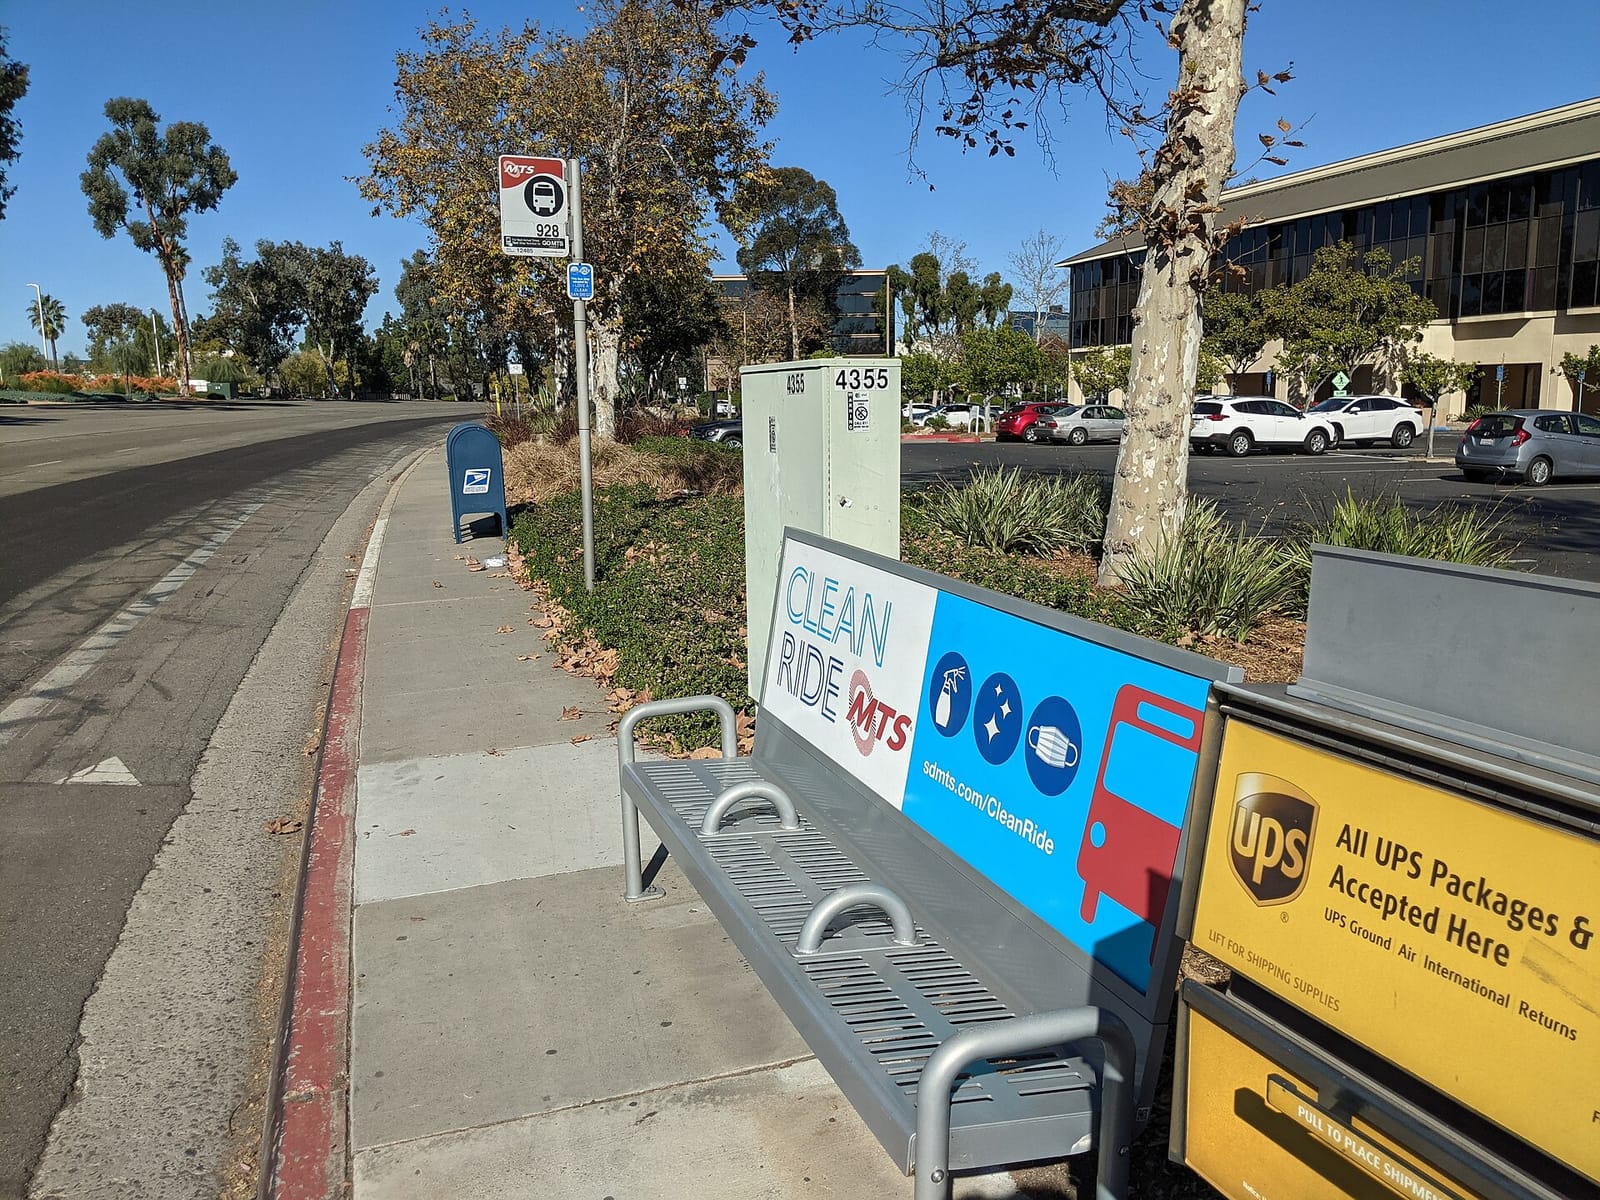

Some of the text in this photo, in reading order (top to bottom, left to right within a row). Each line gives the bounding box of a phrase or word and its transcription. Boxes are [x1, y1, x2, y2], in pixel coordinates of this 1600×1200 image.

[504, 164, 535, 175] MTS
[536, 223, 560, 238] 928
[787, 373, 805, 394] 4355
[835, 368, 889, 390] 4355
[786, 566, 892, 668] CLEAN
[776, 630, 844, 723] RIDE
[846, 690, 912, 752] MTS
[922, 760, 1055, 855] sdmts.com/CleanRide
[1233, 806, 1307, 885] ups
[1328, 864, 1511, 968] Accepted Here
[1335, 824, 1595, 951] All UPS Packages &
[1208, 929, 1341, 1012] LIFT FOR SHIPPING SUPPLIES
[1324, 907, 1578, 1042] UPS Ground Air International Returns
[1297, 1104, 1324, 1132] PULL
[1326, 1122, 1342, 1143] TO
[1344, 1135, 1381, 1170] PLACE
